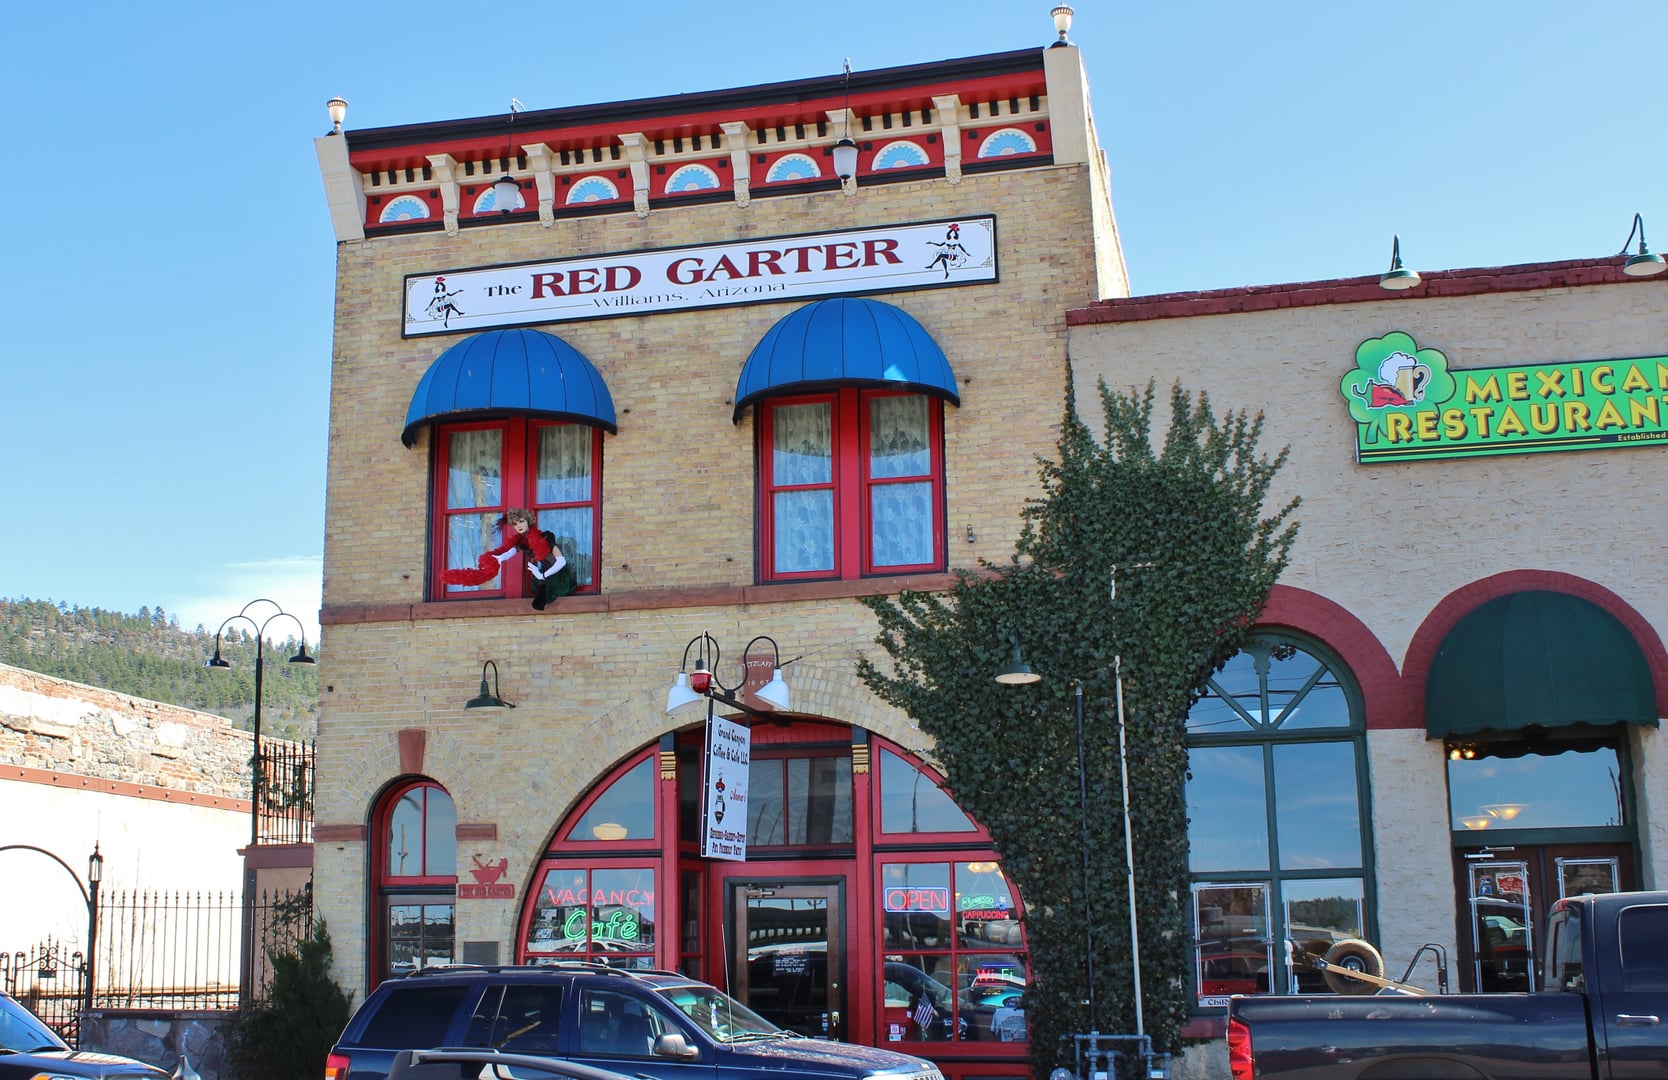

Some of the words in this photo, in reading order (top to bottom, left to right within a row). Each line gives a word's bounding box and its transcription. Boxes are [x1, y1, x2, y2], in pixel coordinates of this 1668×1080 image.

[483, 282, 523, 299] The
[530, 265, 642, 300] RED
[666, 238, 903, 285] GARTER
[699, 281, 786, 299] Arizona
[1617, 432, 1667, 441] Established
[718, 723, 731, 741] Grand
[731, 729, 745, 746] Canyon
[740, 751, 749, 766] LLC
[548, 889, 655, 905] VACANCY
[888, 890, 946, 910] OPEN
[564, 910, 637, 940] Café
